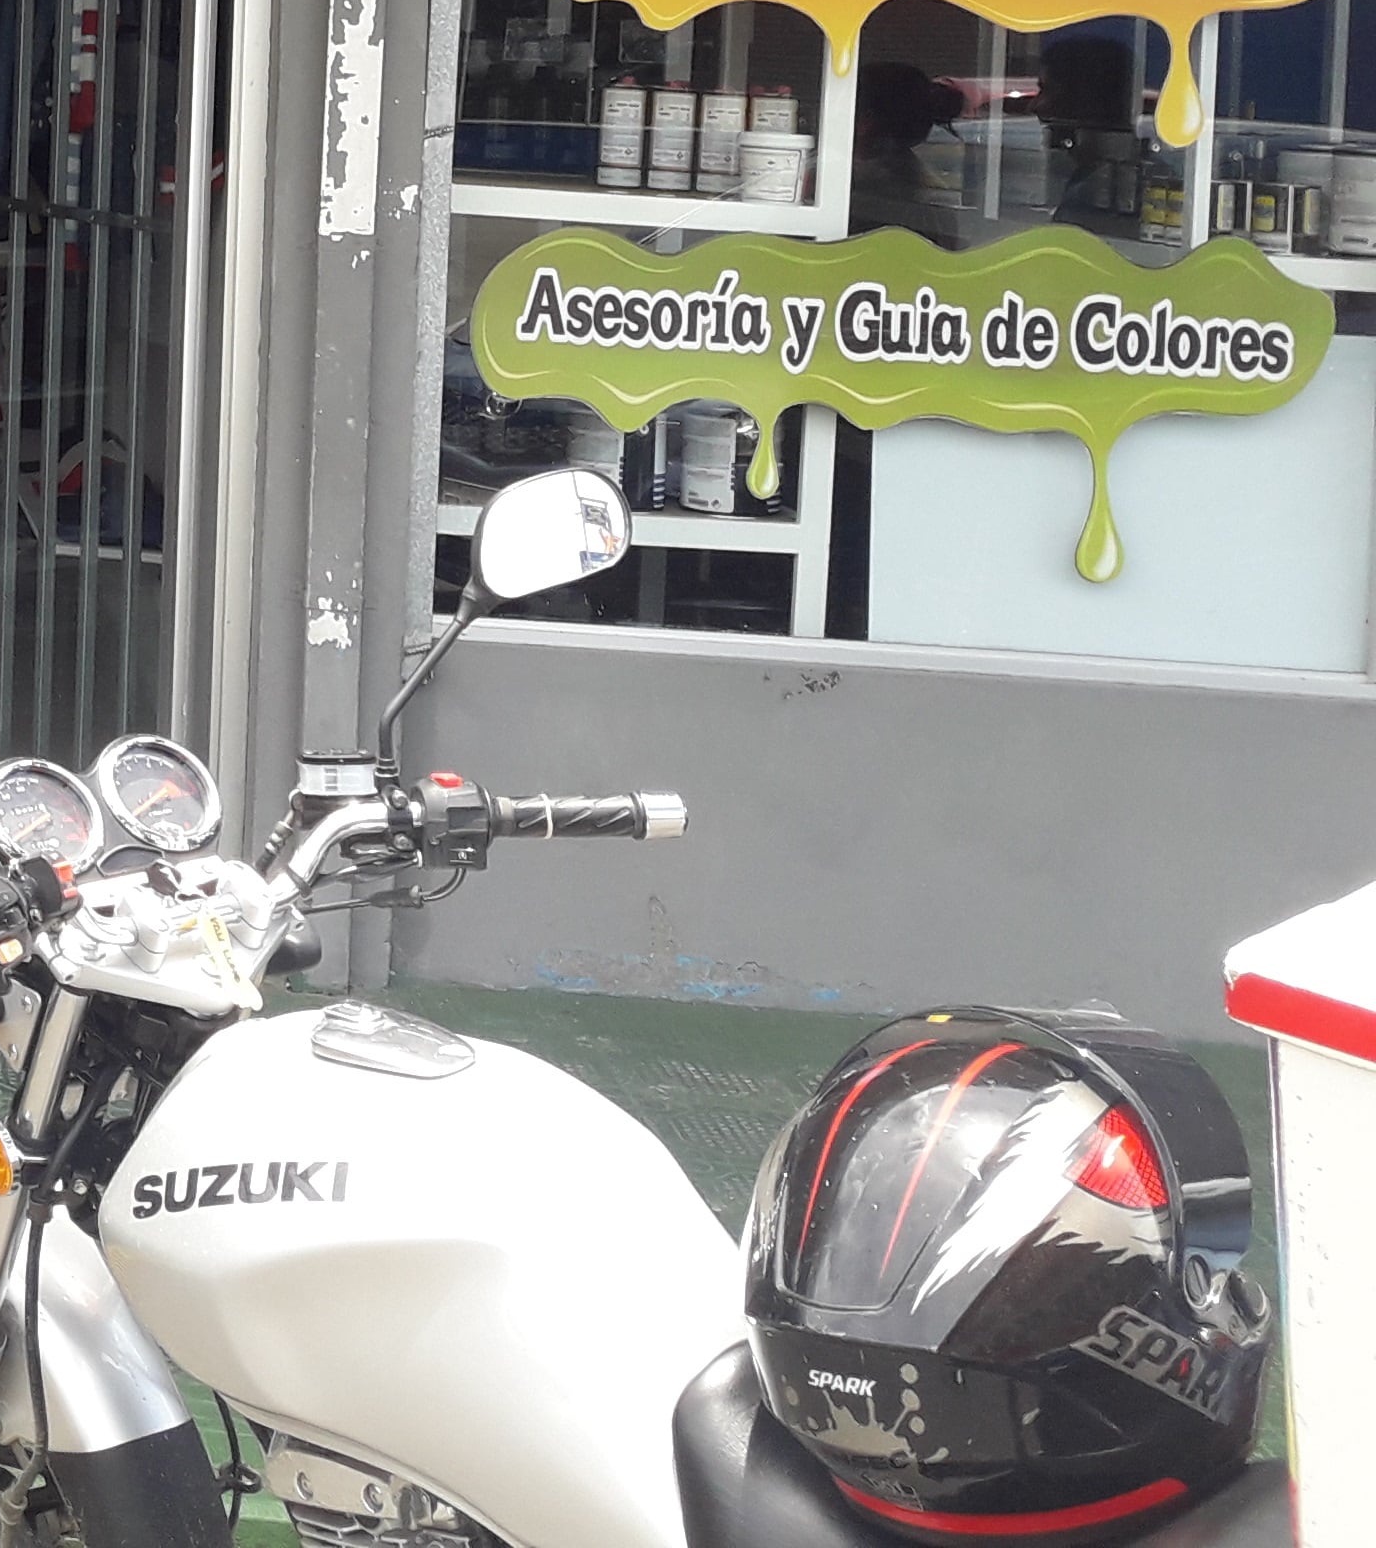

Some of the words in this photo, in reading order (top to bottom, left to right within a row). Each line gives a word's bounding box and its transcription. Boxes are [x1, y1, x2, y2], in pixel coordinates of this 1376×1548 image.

[522, 271, 766, 344] Asesoría
[786, 300, 820, 369] y
[839, 288, 966, 359] Guia
[986, 296, 1055, 365] de
[1076, 303, 1291, 376] Colores
[132, 1160, 348, 1220] SUZUKI
[807, 1369, 877, 1398] SPARK
